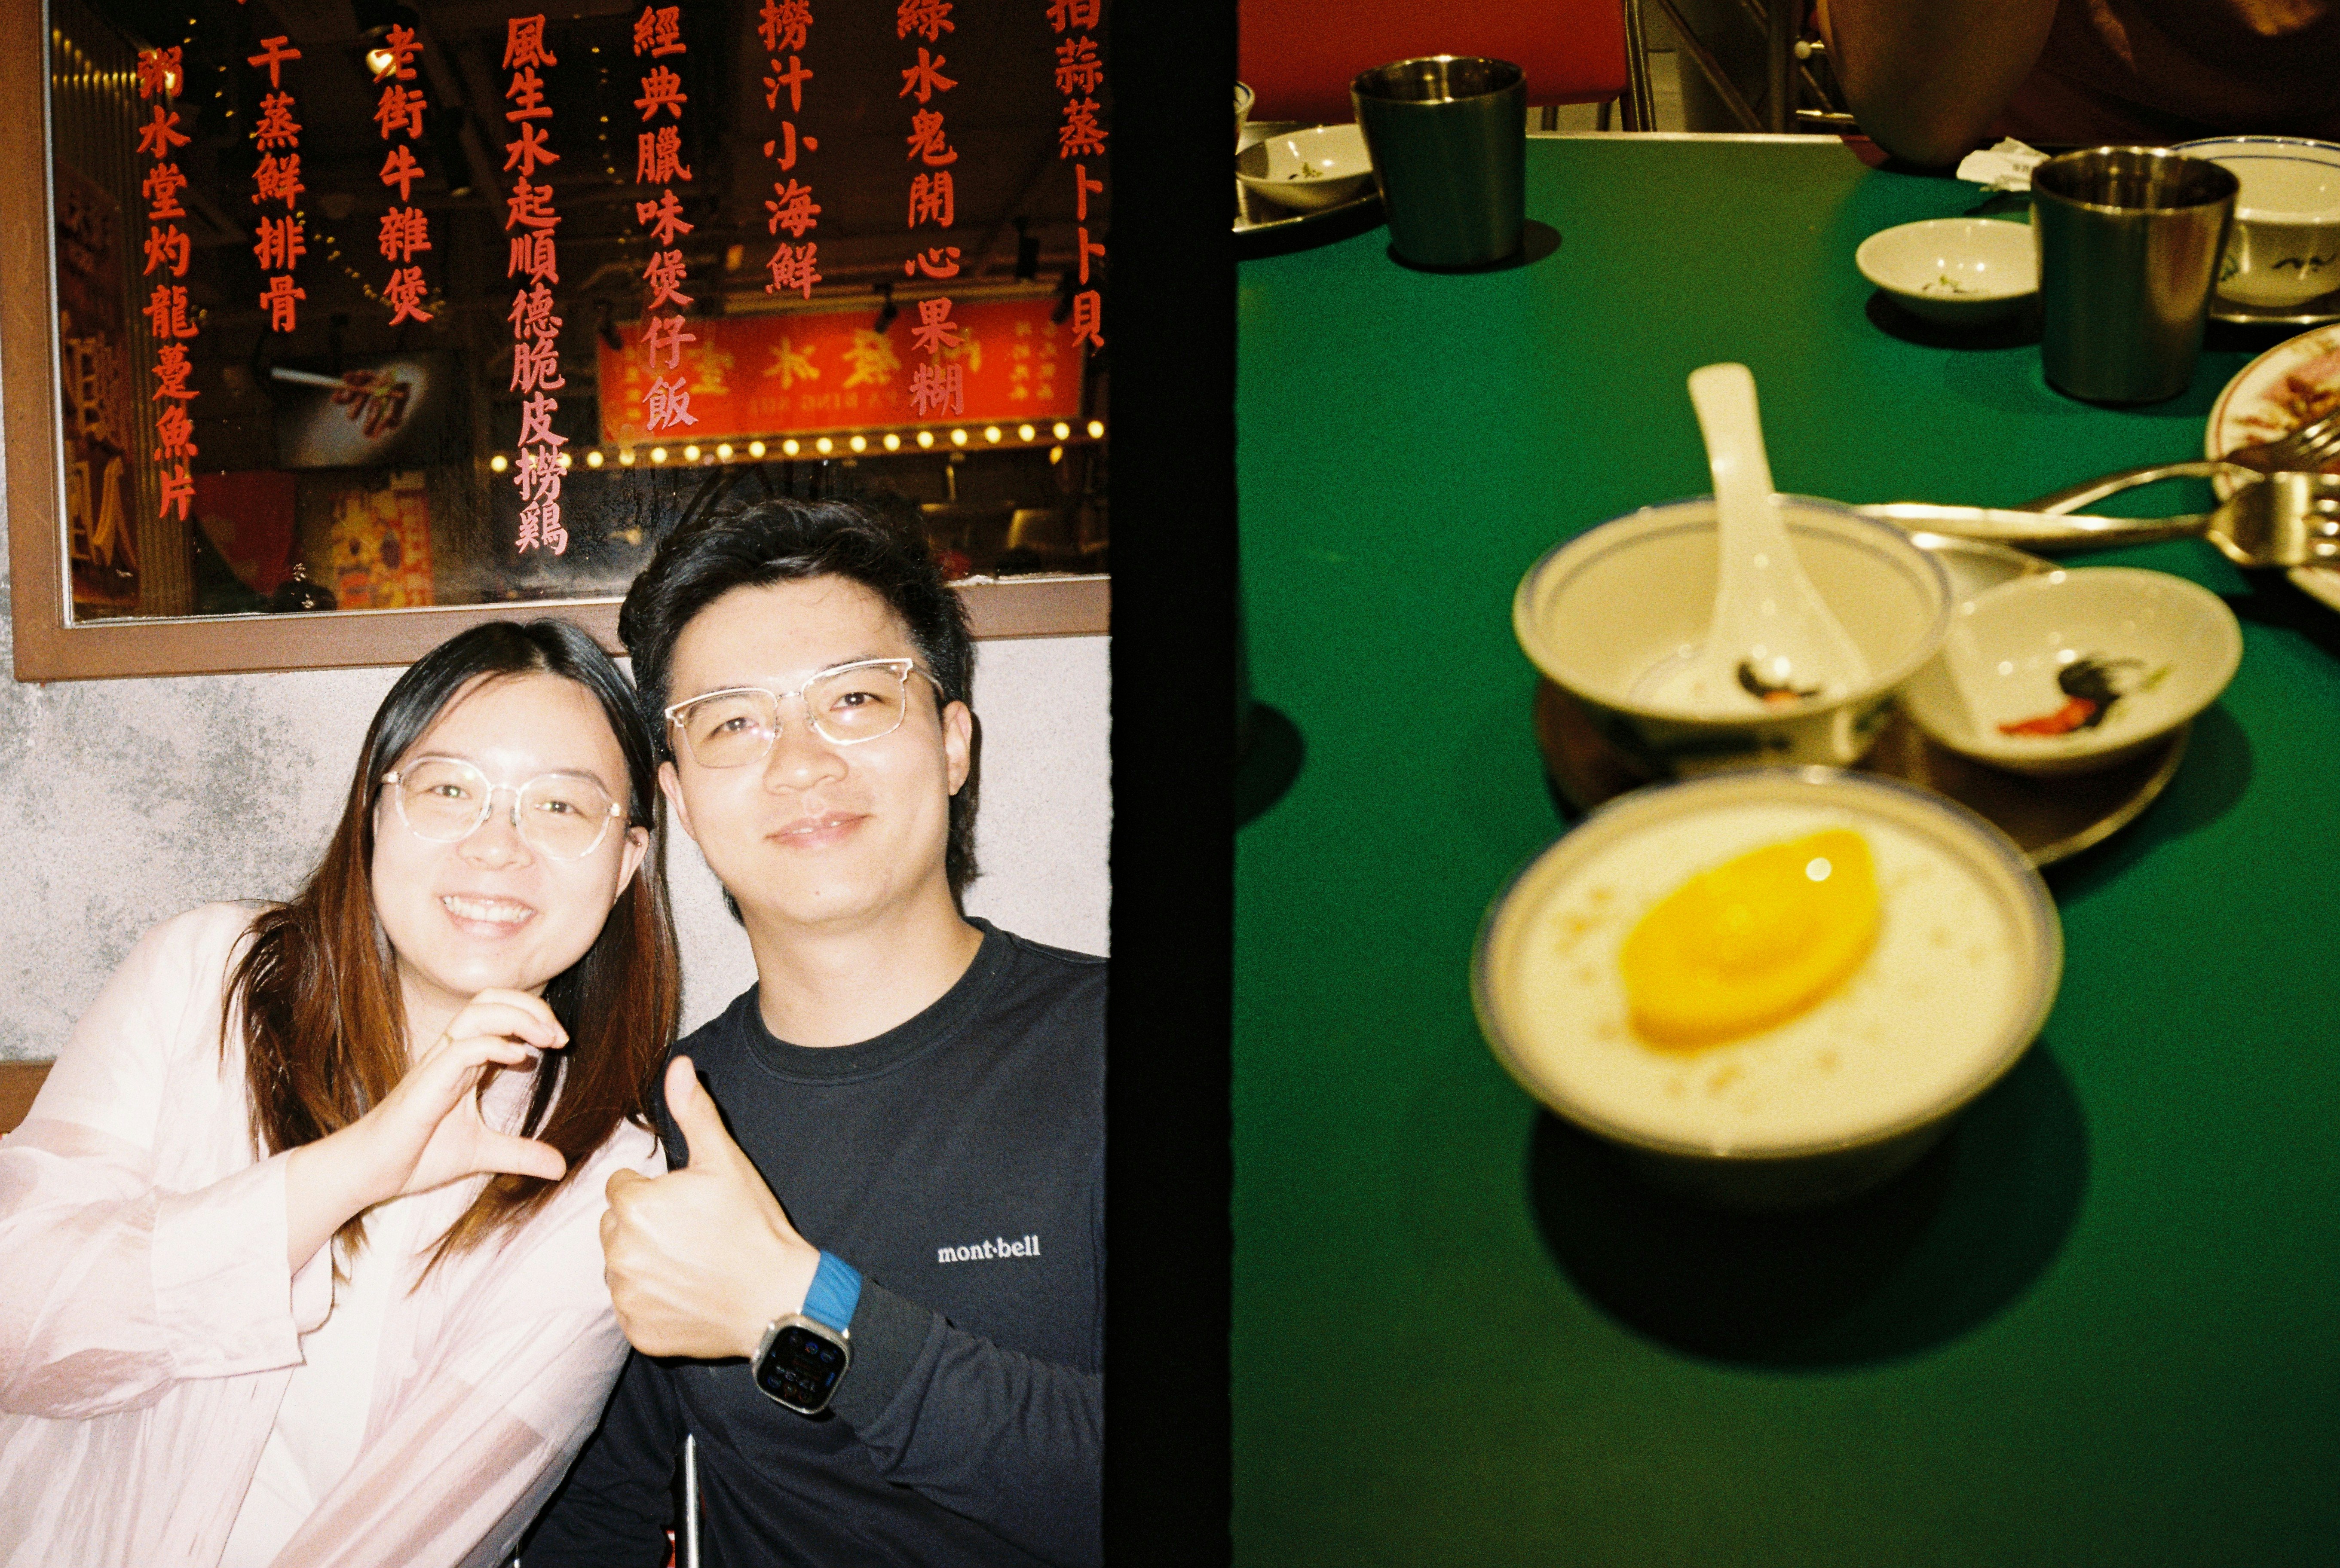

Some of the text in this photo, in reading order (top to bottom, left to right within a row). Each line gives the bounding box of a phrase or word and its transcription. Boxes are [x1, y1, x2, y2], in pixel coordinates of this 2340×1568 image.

[248, 36, 306, 333] 干蒸鮮排骨
[374, 24, 434, 326] 老街牛雜煲
[634, 6, 699, 431] 經典臘味煲仔飯
[758, 0, 822, 302] 撈汁小海鮮
[1046, 0, 1109, 348] 拍蒜蒸卜卜貝
